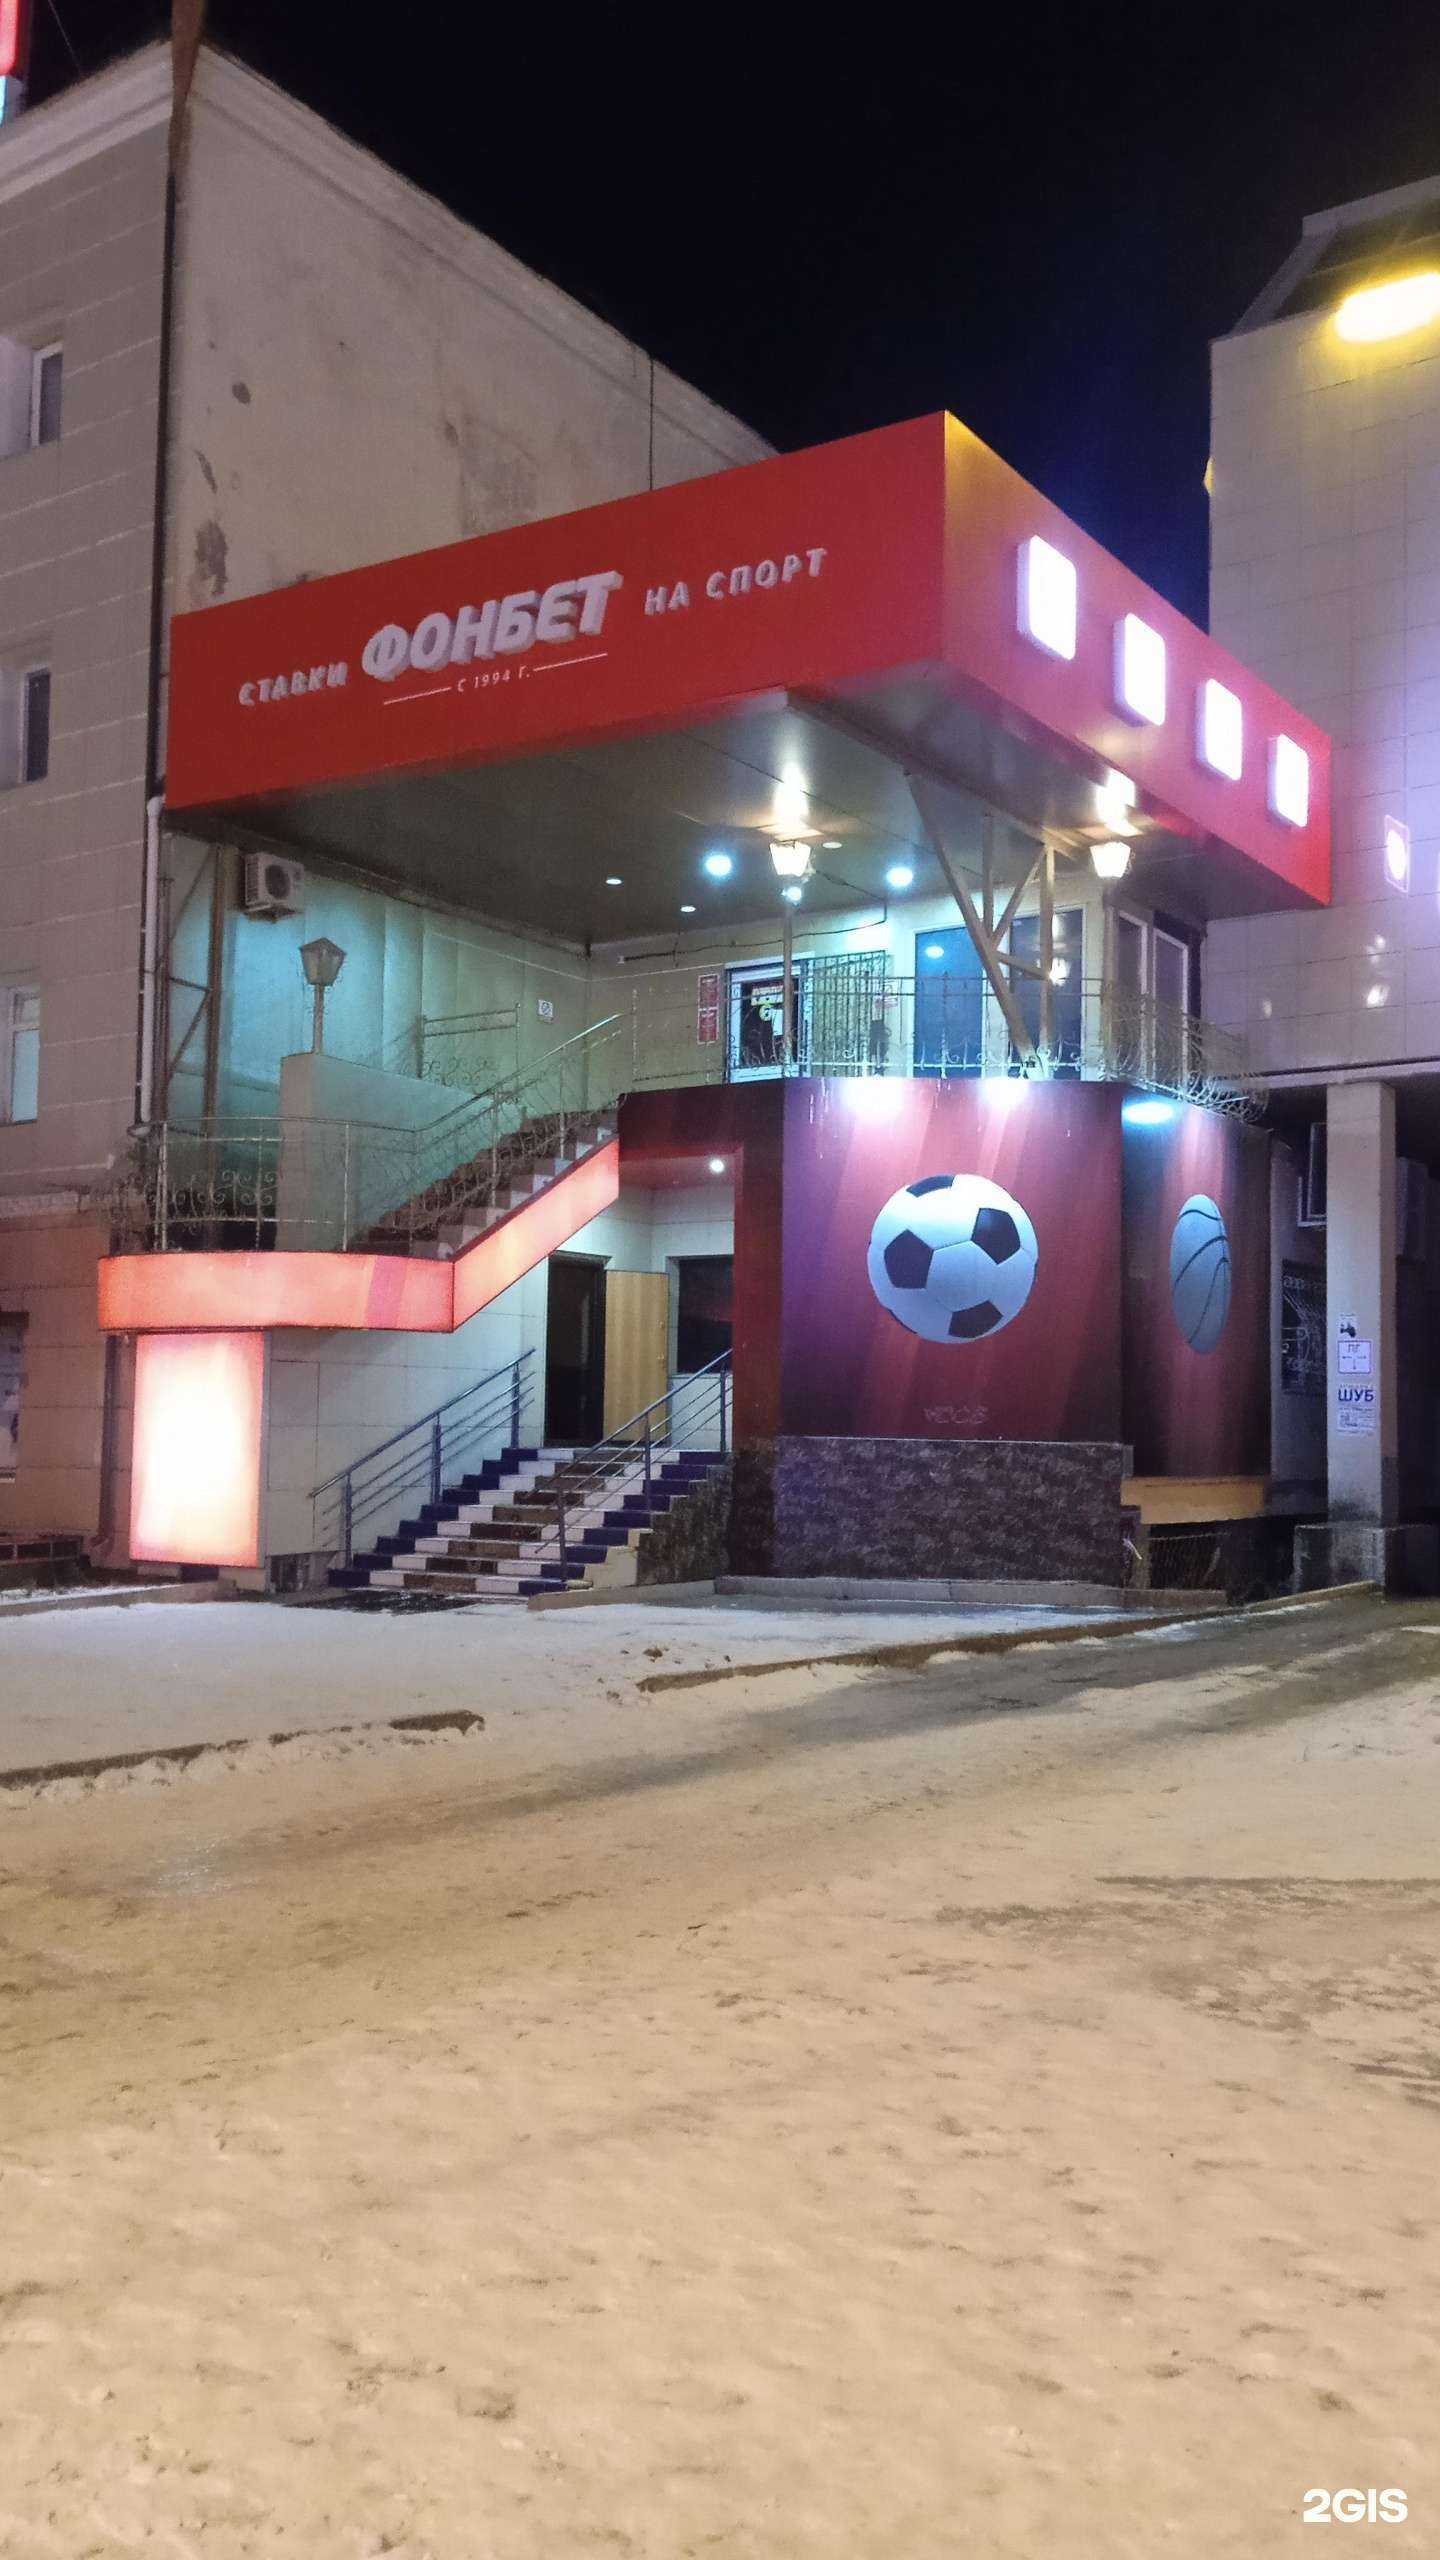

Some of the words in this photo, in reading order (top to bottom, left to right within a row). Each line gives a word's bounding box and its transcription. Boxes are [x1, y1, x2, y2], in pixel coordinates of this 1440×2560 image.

[238, 661, 348, 707] СТАВКИ
[361, 570, 624, 682] ФОНБЕТ
[644, 581, 690, 616] НА
[706, 547, 828, 600] СПОРТ
[457, 678, 467, 693] С
[473, 669, 512, 689] 1994
[1338, 1388, 1375, 1402] ШУБ
